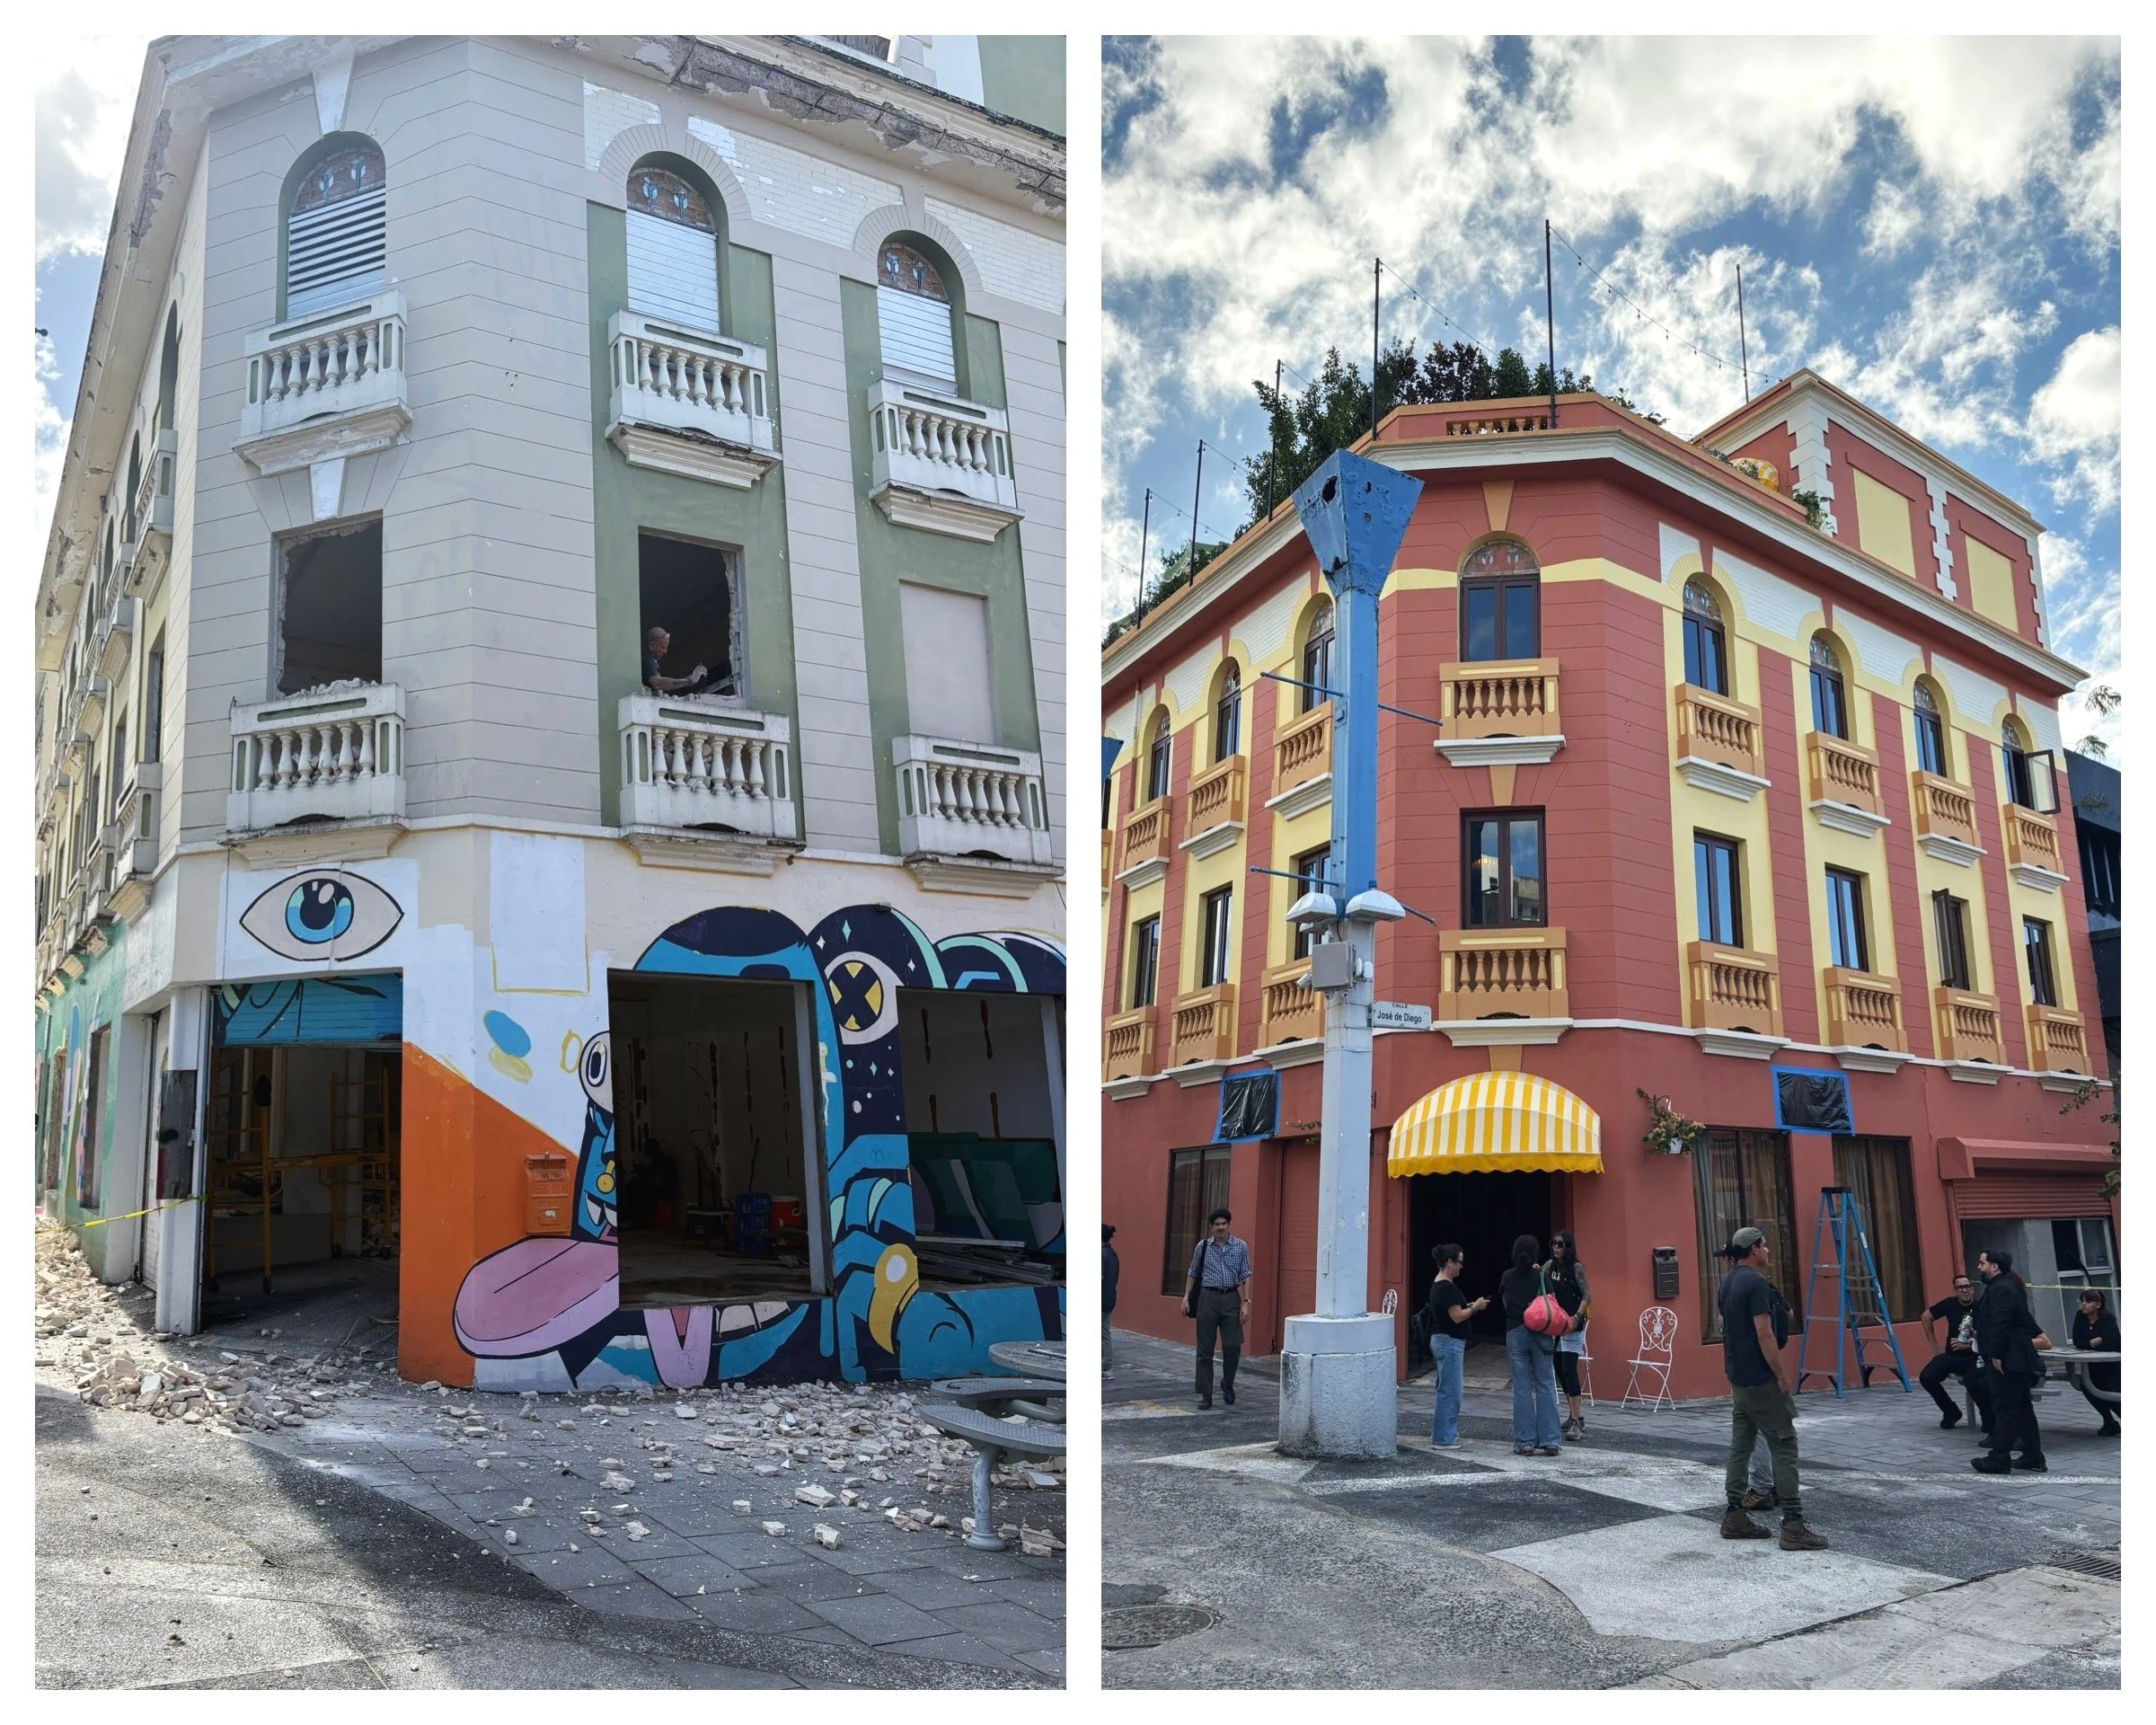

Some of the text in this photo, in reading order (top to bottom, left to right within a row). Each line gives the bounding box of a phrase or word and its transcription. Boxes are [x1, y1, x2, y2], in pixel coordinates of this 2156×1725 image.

[1377, 1011, 1422, 1024] José de Diego
